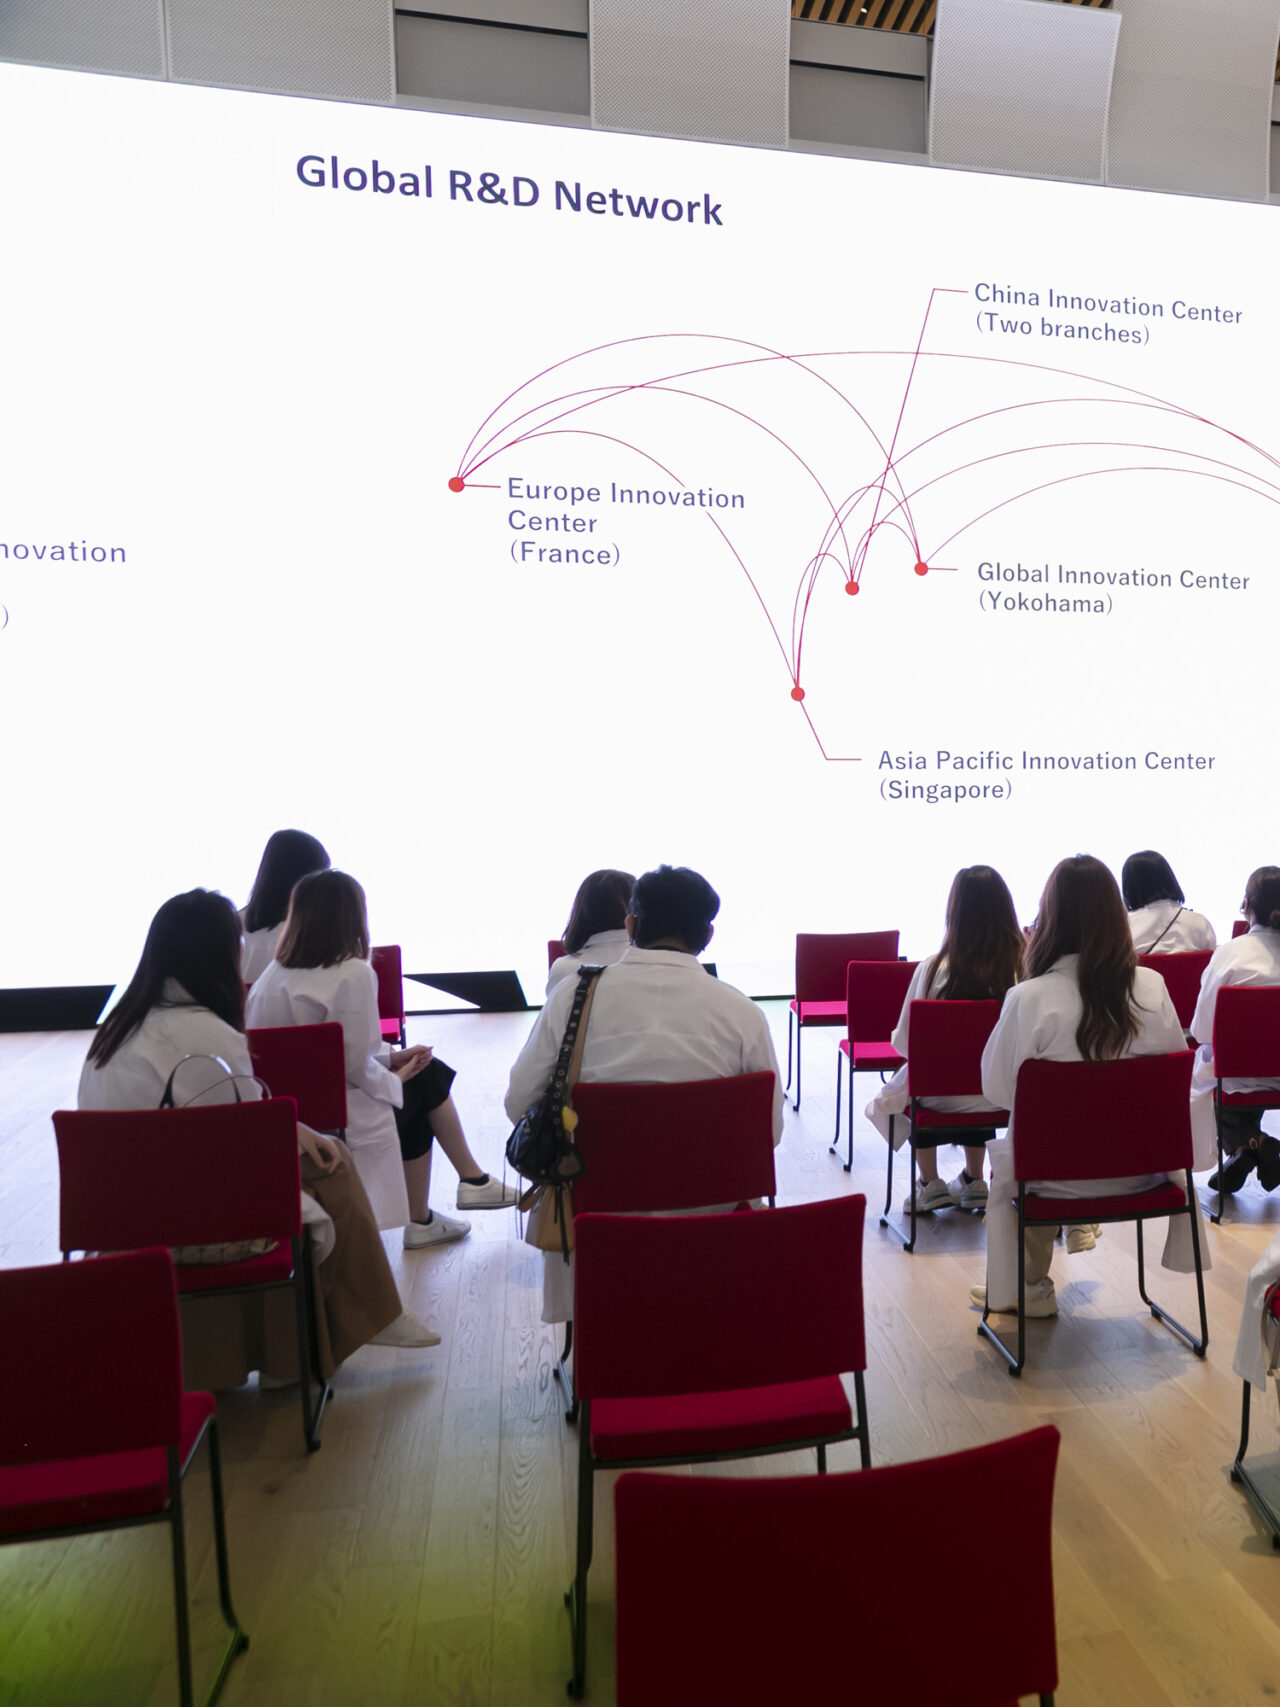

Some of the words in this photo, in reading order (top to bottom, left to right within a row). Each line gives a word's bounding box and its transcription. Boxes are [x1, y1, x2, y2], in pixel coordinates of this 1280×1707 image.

[296, 155, 432, 198] Global
[449, 170, 540, 207] R&D
[555, 180, 723, 226] Network
[975, 283, 1039, 306] China
[1049, 289, 1163, 317] Innovation
[1172, 301, 1243, 324] Center
[977, 311, 1032, 335] (Two
[1041, 317, 1149, 345] branches)
[508, 477, 600, 506] Europe
[612, 482, 744, 508] Innovation
[508, 510, 597, 533] Center
[511, 539, 620, 567] (France)
[978, 562, 1048, 582] Global
[1059, 565, 1171, 587] Innovation
[1180, 570, 1250, 590] Center
[980, 589, 1112, 615] (Yokohama)
[878, 751, 926, 770] Asia
[937, 751, 1013, 770] Pacific
[1023, 751, 1136, 770] Innovation
[1145, 752, 1215, 769] Center
[880, 778, 1011, 803] (Singapore)
